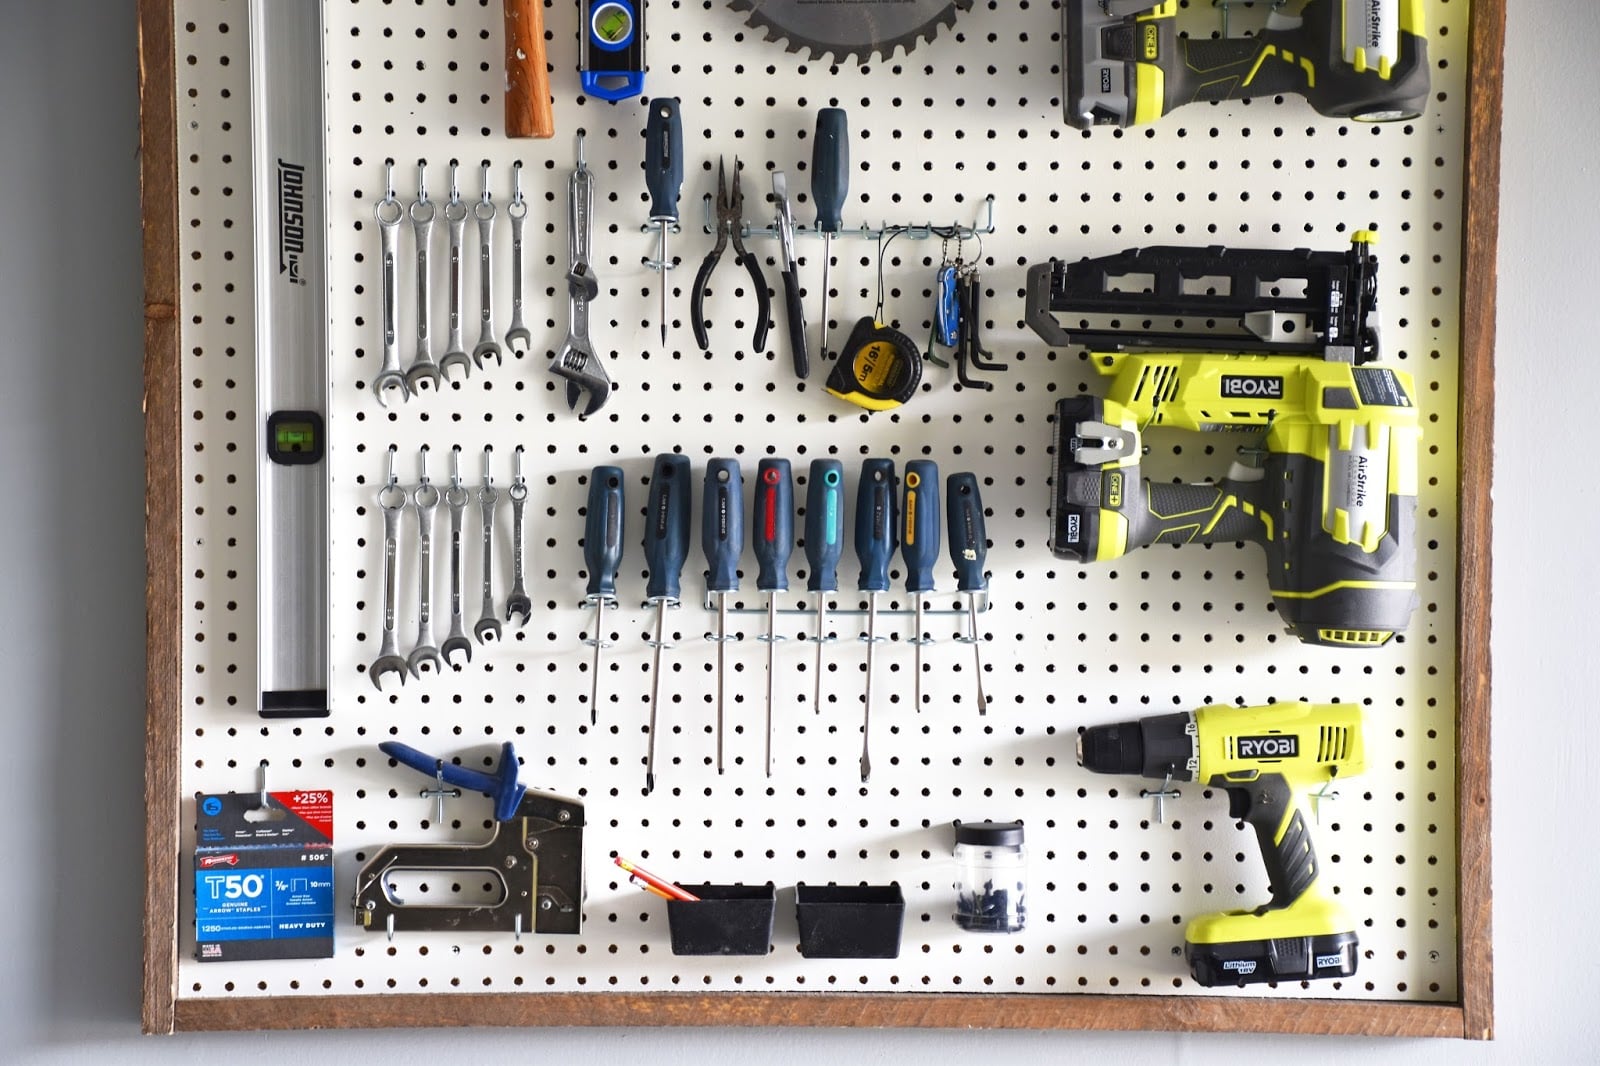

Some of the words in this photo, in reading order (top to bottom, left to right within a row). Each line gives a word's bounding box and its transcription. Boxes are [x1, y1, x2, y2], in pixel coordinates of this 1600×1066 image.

[1371, 0, 1381, 48] AirStrike
[1146, 27, 1155, 56] ONE+
[1102, 68, 1110, 91] RYOBI
[277, 157, 304, 254] JOHNSON
[1225, 378, 1281, 396] RYOBI
[1111, 474, 1119, 503] ONE+
[1356, 455, 1368, 507] AirStrike
[1070, 515, 1078, 540] RYOBI
[1187, 723, 1196, 733] 16
[1240, 738, 1296, 756] RYOBI
[1188, 760, 1197, 769] 12
[292, 792, 329, 804] +25%
[205, 874, 264, 899] T50
[202, 924, 221, 933] 1250
[1223, 961, 1256, 970] Lithium
